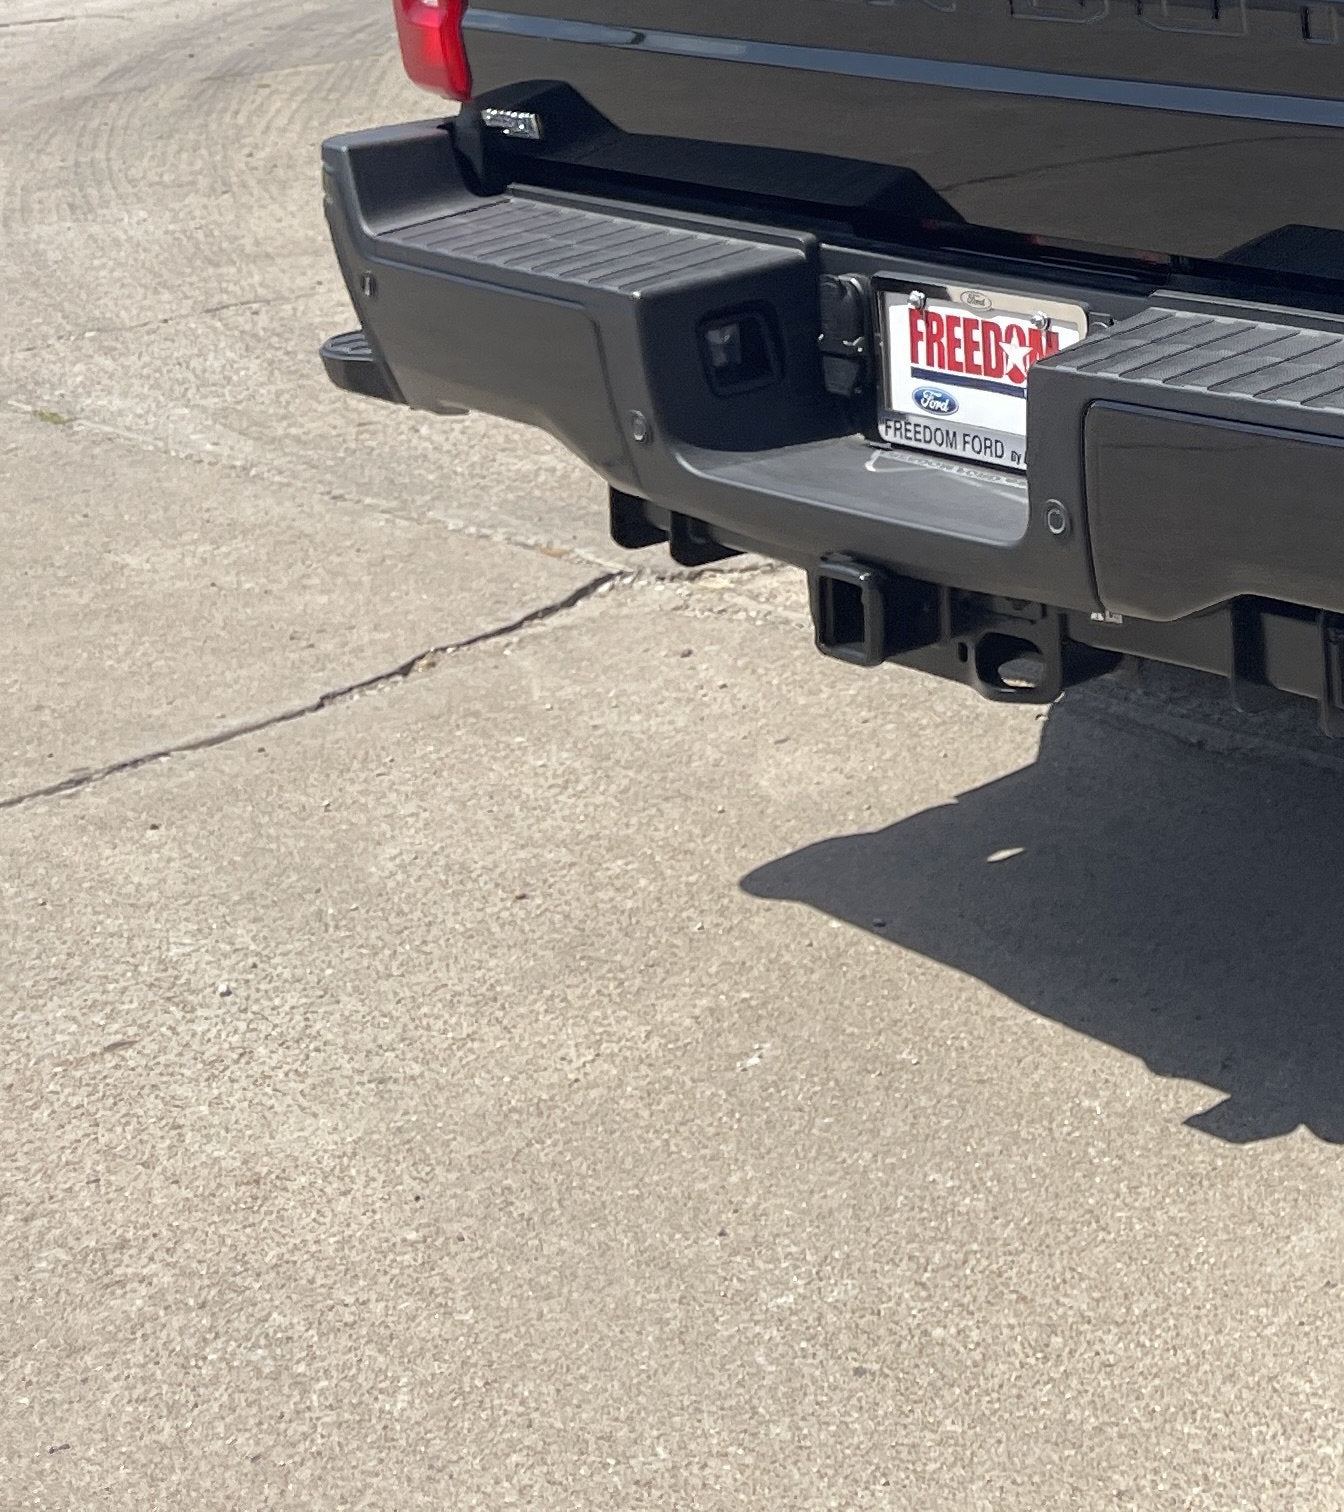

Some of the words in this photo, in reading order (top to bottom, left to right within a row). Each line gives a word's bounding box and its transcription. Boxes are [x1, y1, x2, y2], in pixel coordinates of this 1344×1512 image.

[919, 391, 950, 413] Ford
[884, 418, 958, 450] FREEDOM
[962, 433, 1004, 459] FORD
